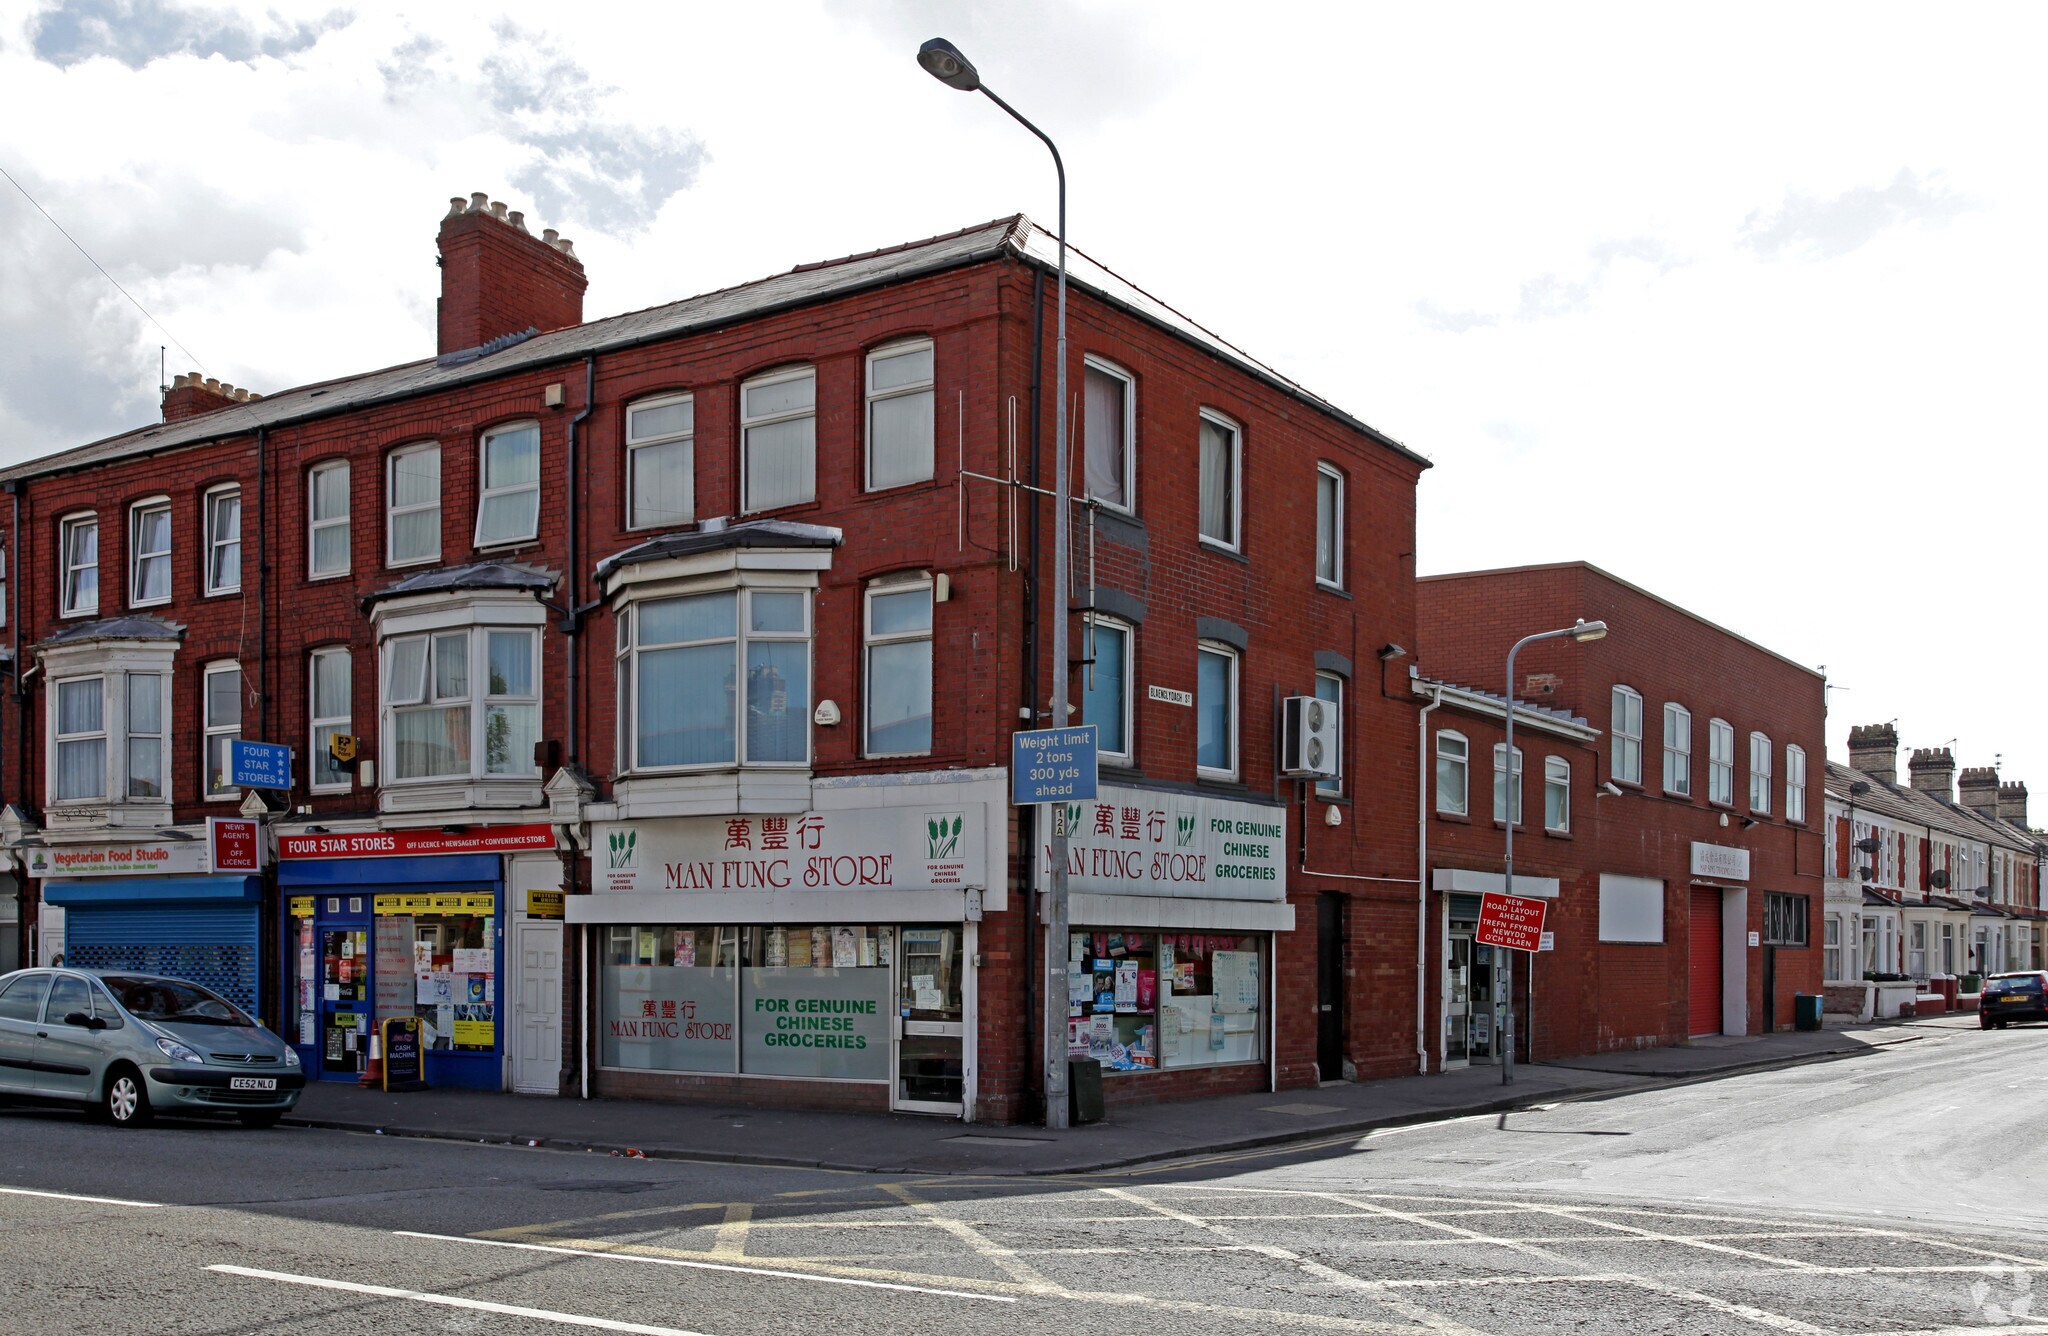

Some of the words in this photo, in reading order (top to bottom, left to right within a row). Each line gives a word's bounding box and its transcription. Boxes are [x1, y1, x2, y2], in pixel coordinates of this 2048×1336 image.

[1020, 735, 1058, 750] Weight
[1064, 732, 1090, 746] limit
[243, 746, 270, 758] FOUR
[1036, 752, 1044, 764] 2
[1046, 752, 1072, 763] tons
[244, 760, 269, 770] STAR
[238, 772, 276, 784] STORES
[1030, 768, 1054, 780] 300
[1058, 766, 1080, 780] yds
[1036, 782, 1072, 796] ahead
[1093, 803, 1166, 843] 萬豐行
[1211, 818, 1232, 834] FOR
[1236, 821, 1281, 838] GENUINE
[724, 816, 826, 851] 萬豐行
[288, 840, 316, 853] FOUR
[320, 838, 348, 852] STAR
[351, 836, 396, 850] STORES
[445, 838, 480, 847] NEWSAGENT
[485, 836, 526, 846] CONVENIENCE
[526, 835, 546, 843] STORE
[53, 851, 104, 867] Vegetarian
[108, 849, 132, 861] Food
[136, 848, 168, 861] Studio
[1224, 842, 1269, 859] CHINESE
[665, 862, 714, 890] MAN
[722, 859, 792, 888] FUNG
[803, 853, 893, 886] STORE
[1092, 848, 1143, 879] FUNG
[1151, 852, 1206, 882] STORE
[1216, 864, 1276, 880] GROCERIES
[1487, 902, 1508, 911] ROAD
[1511, 906, 1540, 916] LAYOUT
[1506, 898, 1523, 906] NEW
[1499, 912, 1525, 922] AHEAD
[1483, 919, 1507, 928] TREFN
[1510, 923, 1539, 933] FFYRDD
[1493, 928, 1526, 938] NEWYDD
[1507, 938, 1531, 947] BLAEN
[755, 998, 790, 1013] FOR
[794, 999, 876, 1015] GENUINE
[610, 1021, 638, 1036] MAN
[642, 1021, 680, 1038] FUNG
[684, 1022, 732, 1040] STORE
[776, 1016, 854, 1031] CHINESE
[764, 1032, 867, 1049] GROCERIES
[234, 1079, 256, 1088] CE52
